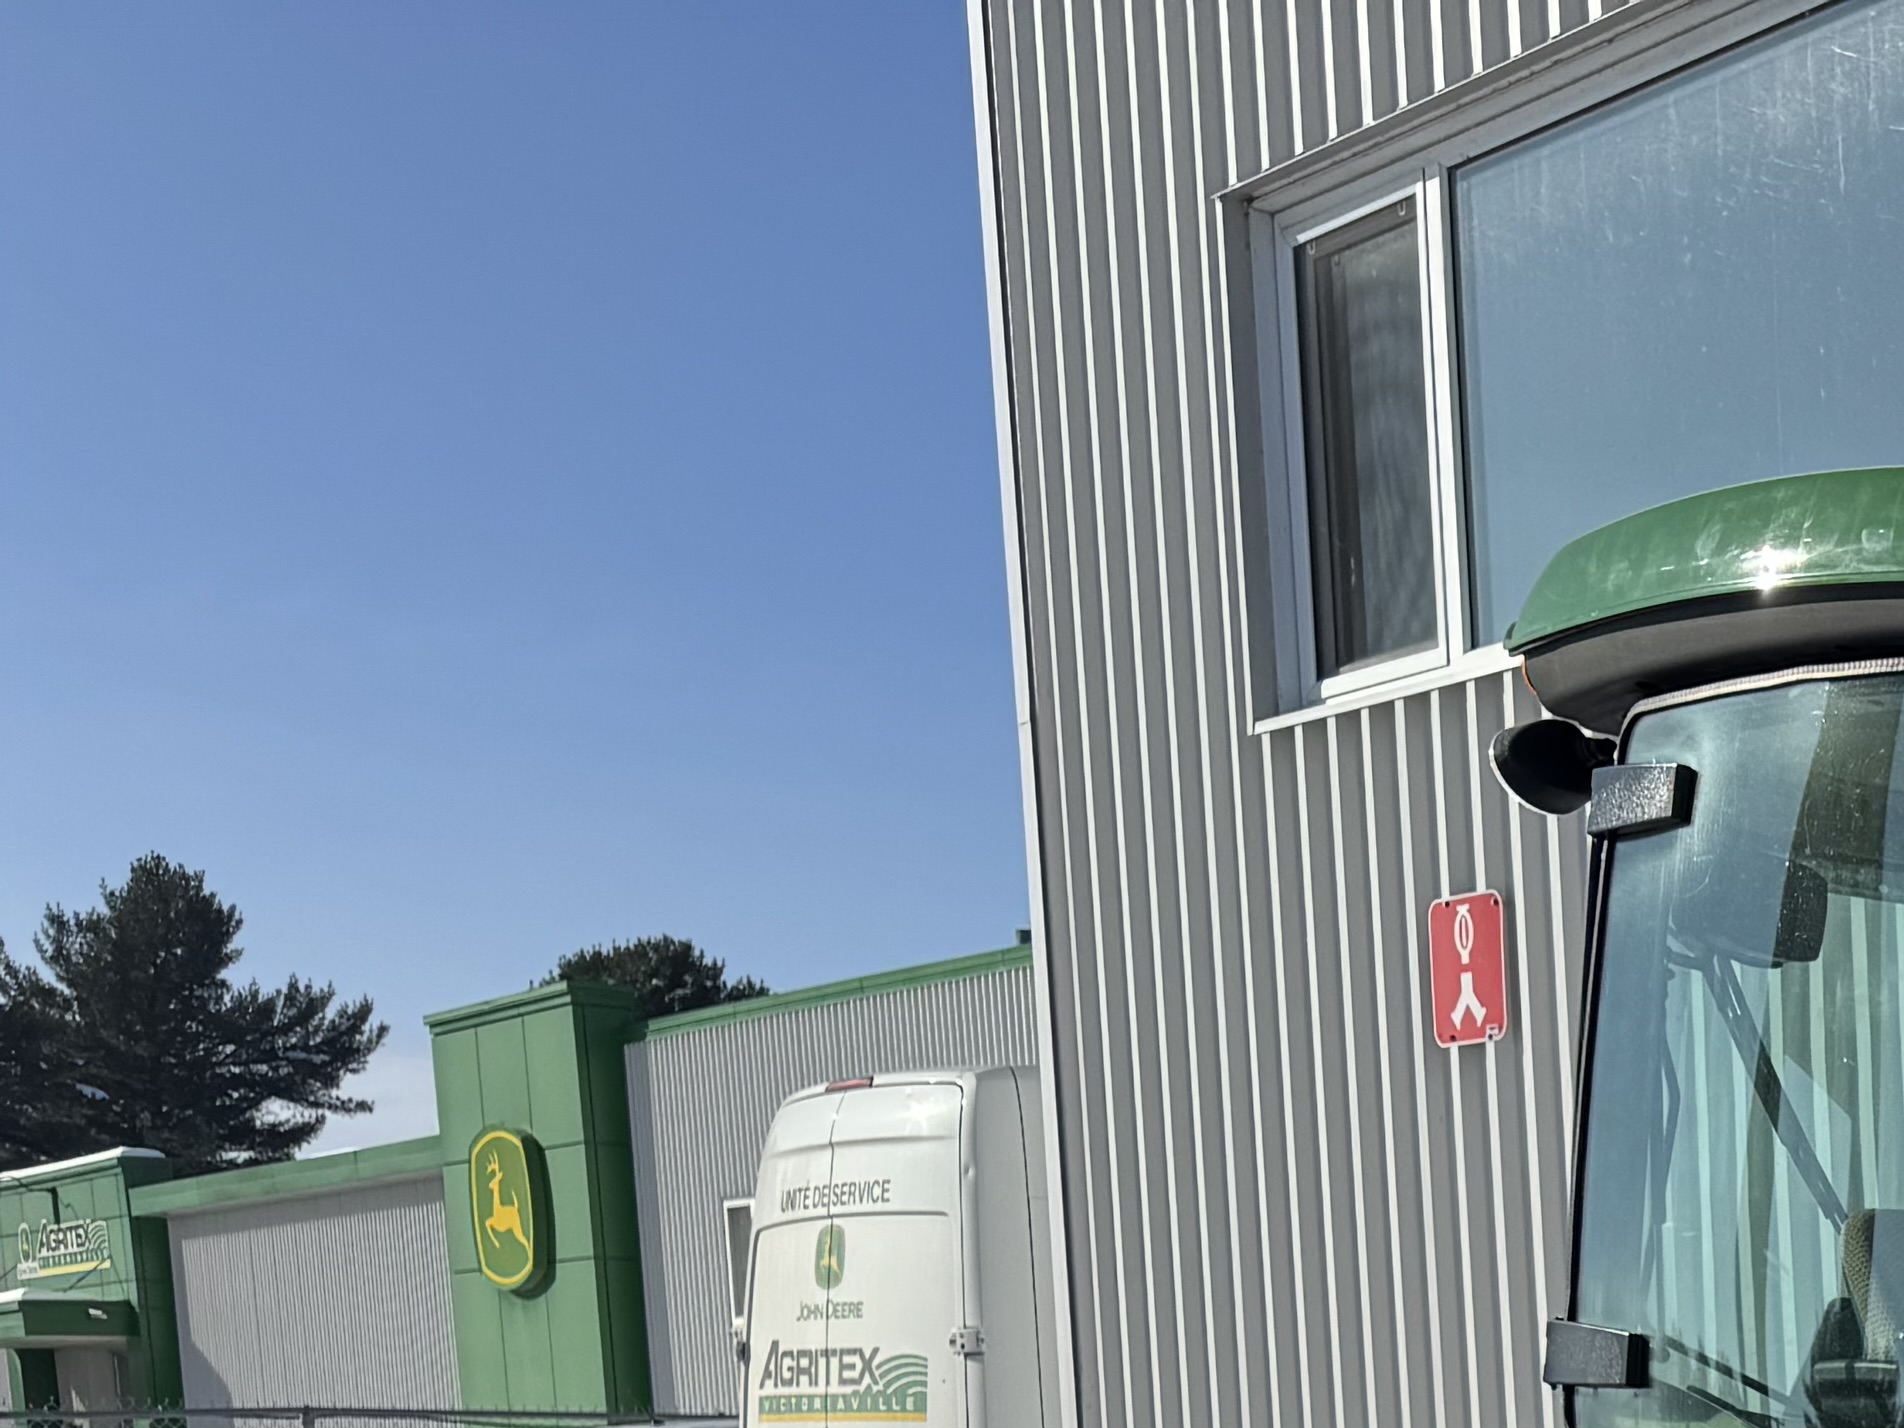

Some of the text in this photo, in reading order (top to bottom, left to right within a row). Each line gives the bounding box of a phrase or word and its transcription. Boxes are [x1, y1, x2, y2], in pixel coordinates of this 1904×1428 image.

[812, 1184, 829, 1209] DE
[832, 1179, 891, 1207] SERVICE
[796, 1299, 864, 1322] JOHN DEERE
[759, 1339, 880, 1390] AGRITEX
